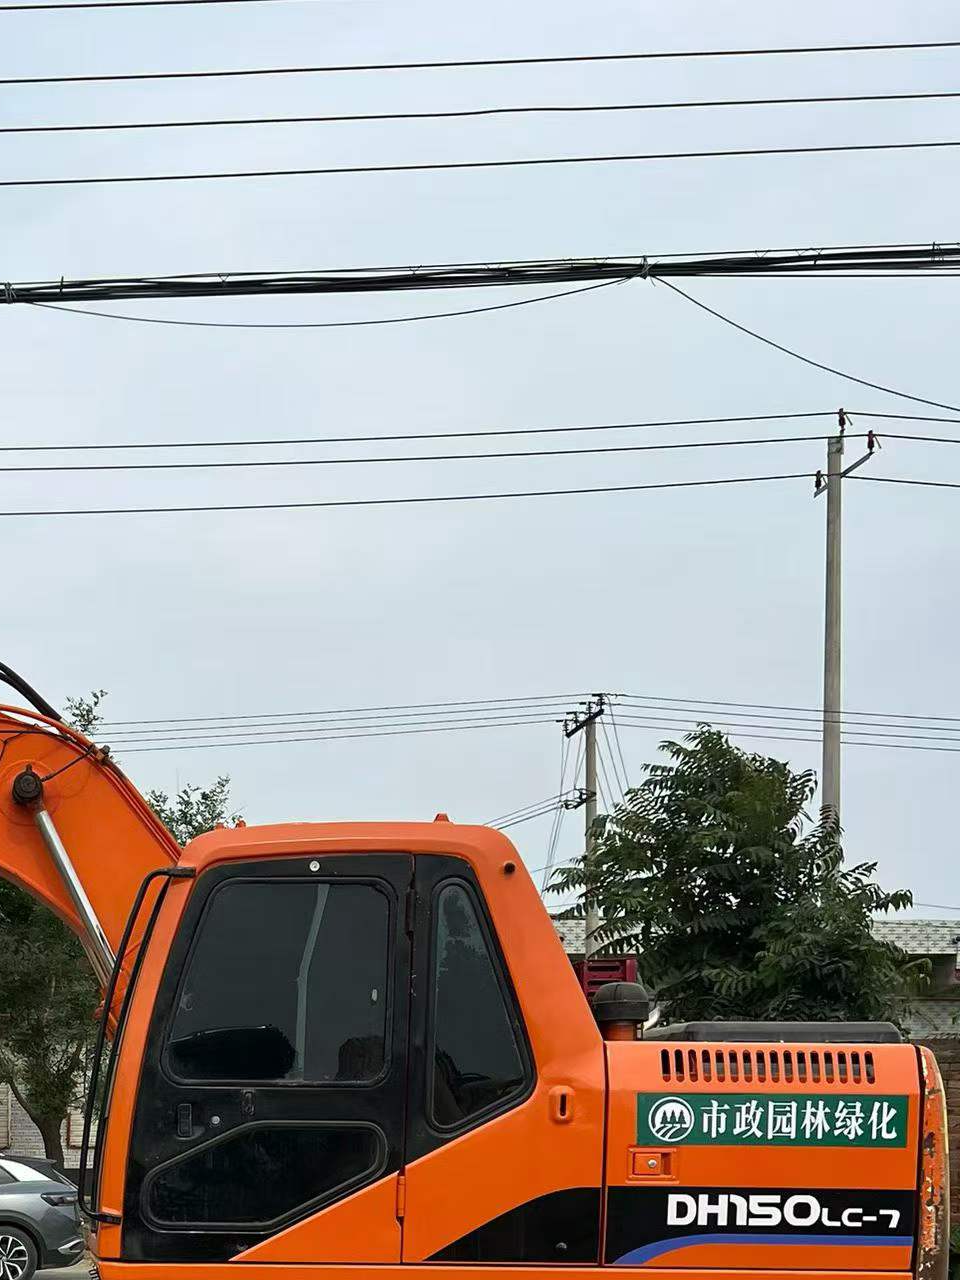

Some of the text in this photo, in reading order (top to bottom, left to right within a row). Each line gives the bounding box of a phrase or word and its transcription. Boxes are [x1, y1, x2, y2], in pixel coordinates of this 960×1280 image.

[700, 1100, 898, 1140] 市政园林绿化
